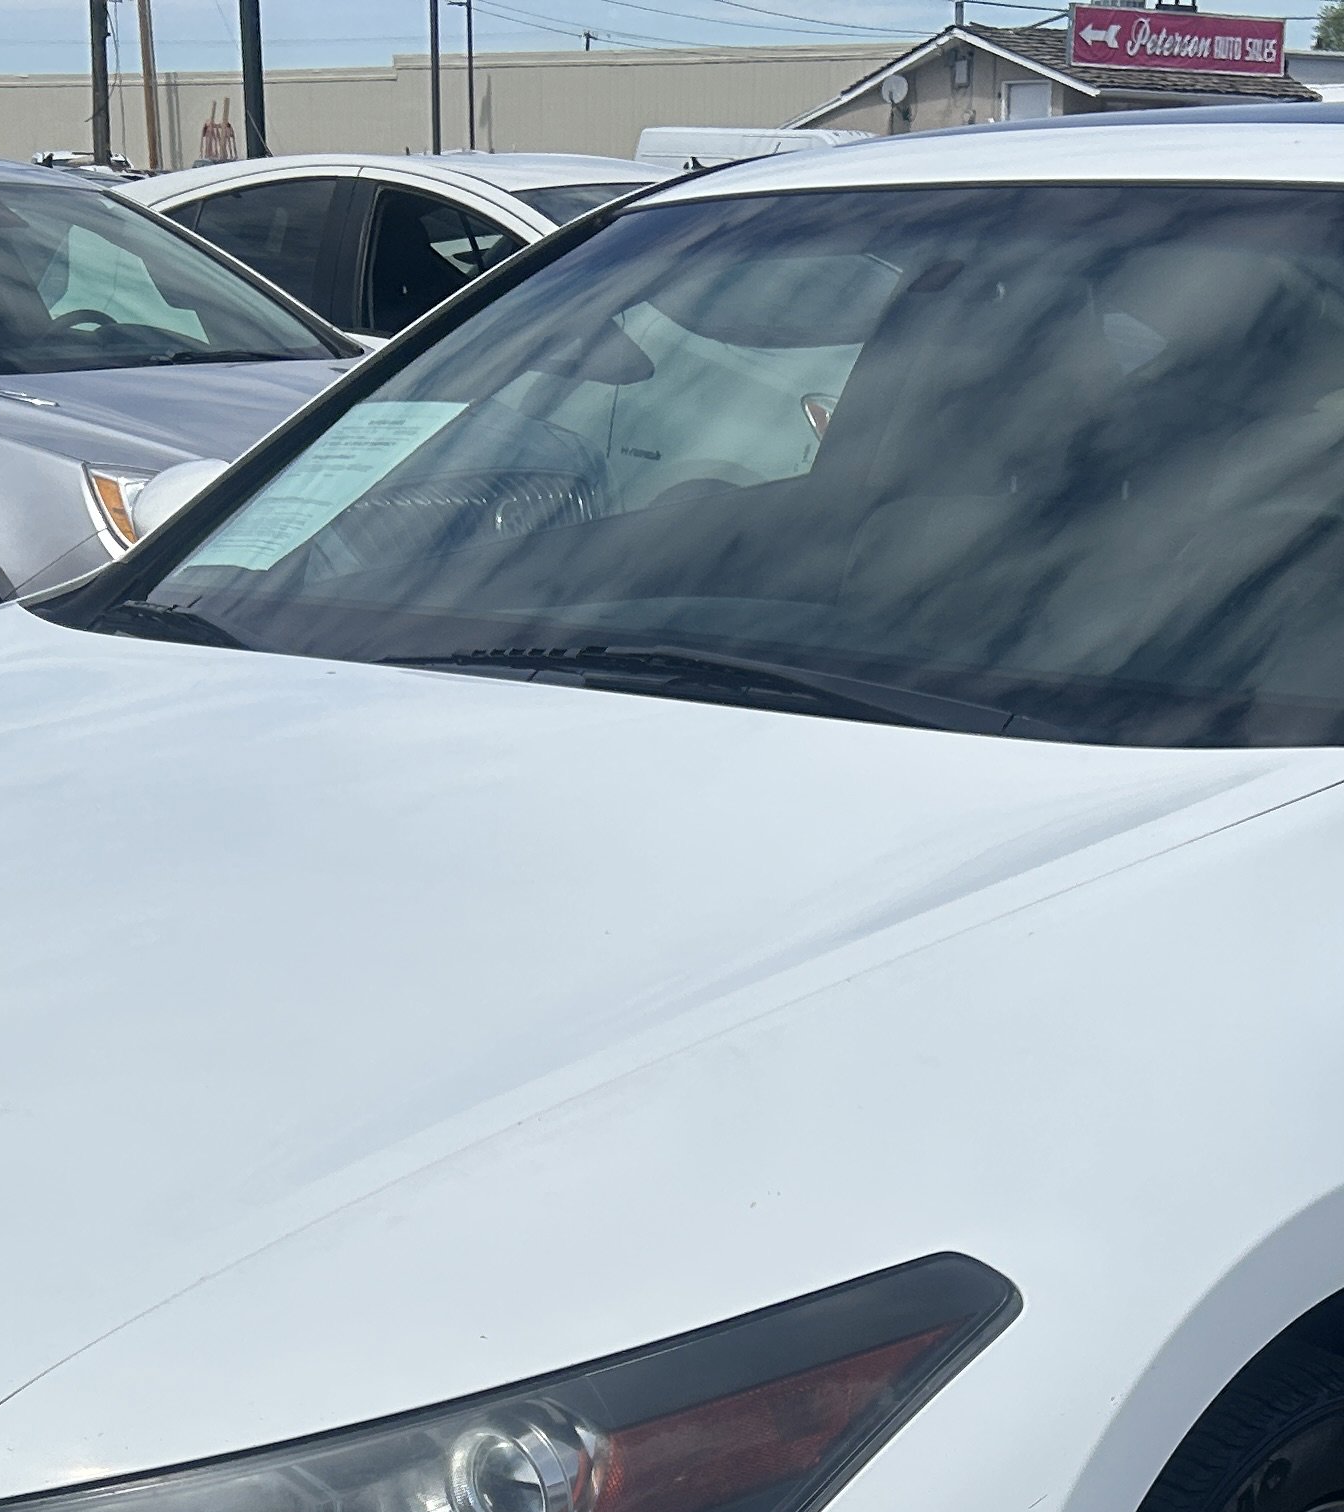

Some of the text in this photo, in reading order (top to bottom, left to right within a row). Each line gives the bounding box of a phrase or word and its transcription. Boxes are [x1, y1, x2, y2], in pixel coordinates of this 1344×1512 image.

[1127, 17, 1277, 62] Peterson AUTO SALES
